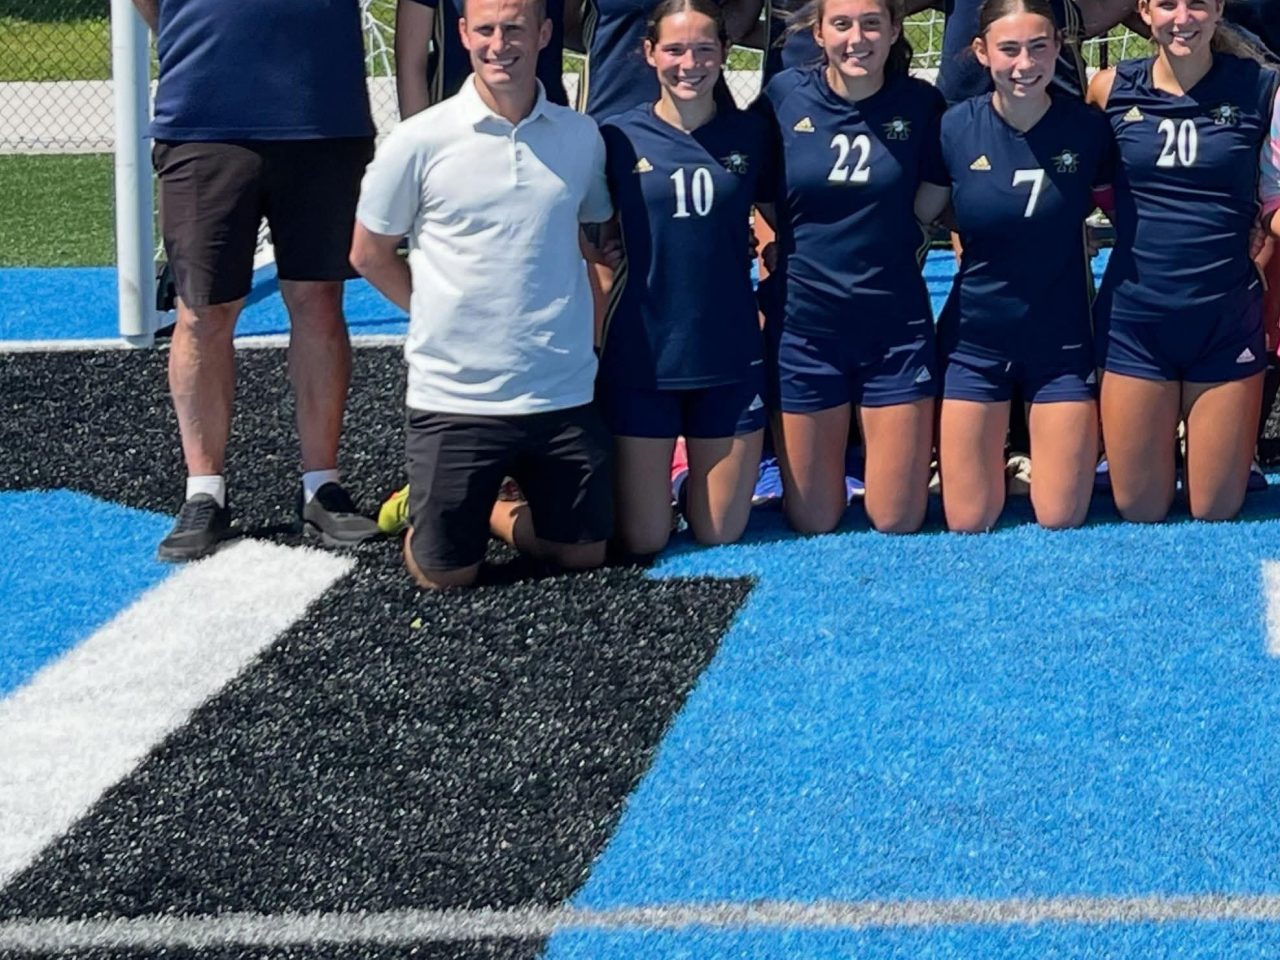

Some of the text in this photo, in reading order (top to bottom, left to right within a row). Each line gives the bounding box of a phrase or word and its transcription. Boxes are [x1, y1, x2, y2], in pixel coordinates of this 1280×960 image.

[828, 134, 870, 181] 22
[1156, 119, 1197, 166] 20
[671, 168, 713, 217] 10
[1013, 169, 1044, 216] 7
